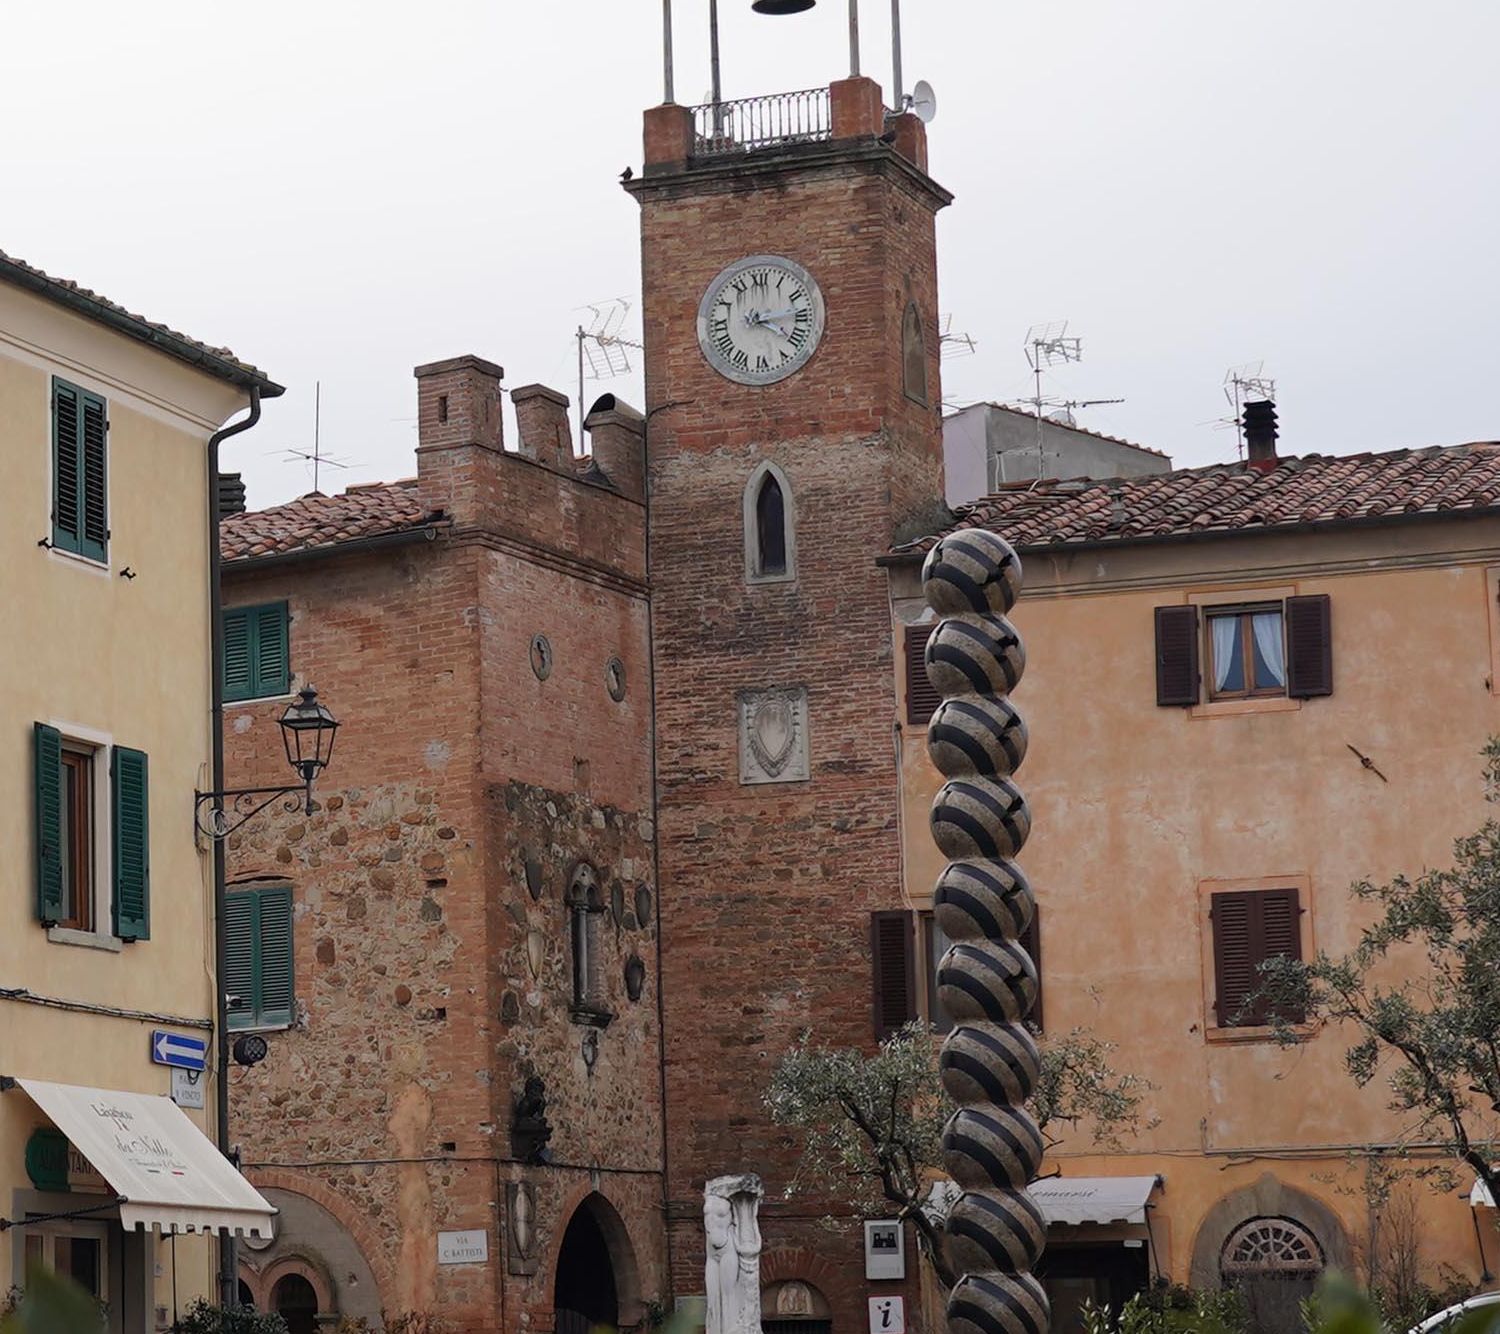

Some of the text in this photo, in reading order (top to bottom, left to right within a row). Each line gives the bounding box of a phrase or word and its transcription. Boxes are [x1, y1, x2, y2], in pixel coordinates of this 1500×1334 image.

[751, 273, 768, 286] XII
[455, 1236, 468, 1244] VIA
[451, 1248, 483, 1258] BATTISTI
